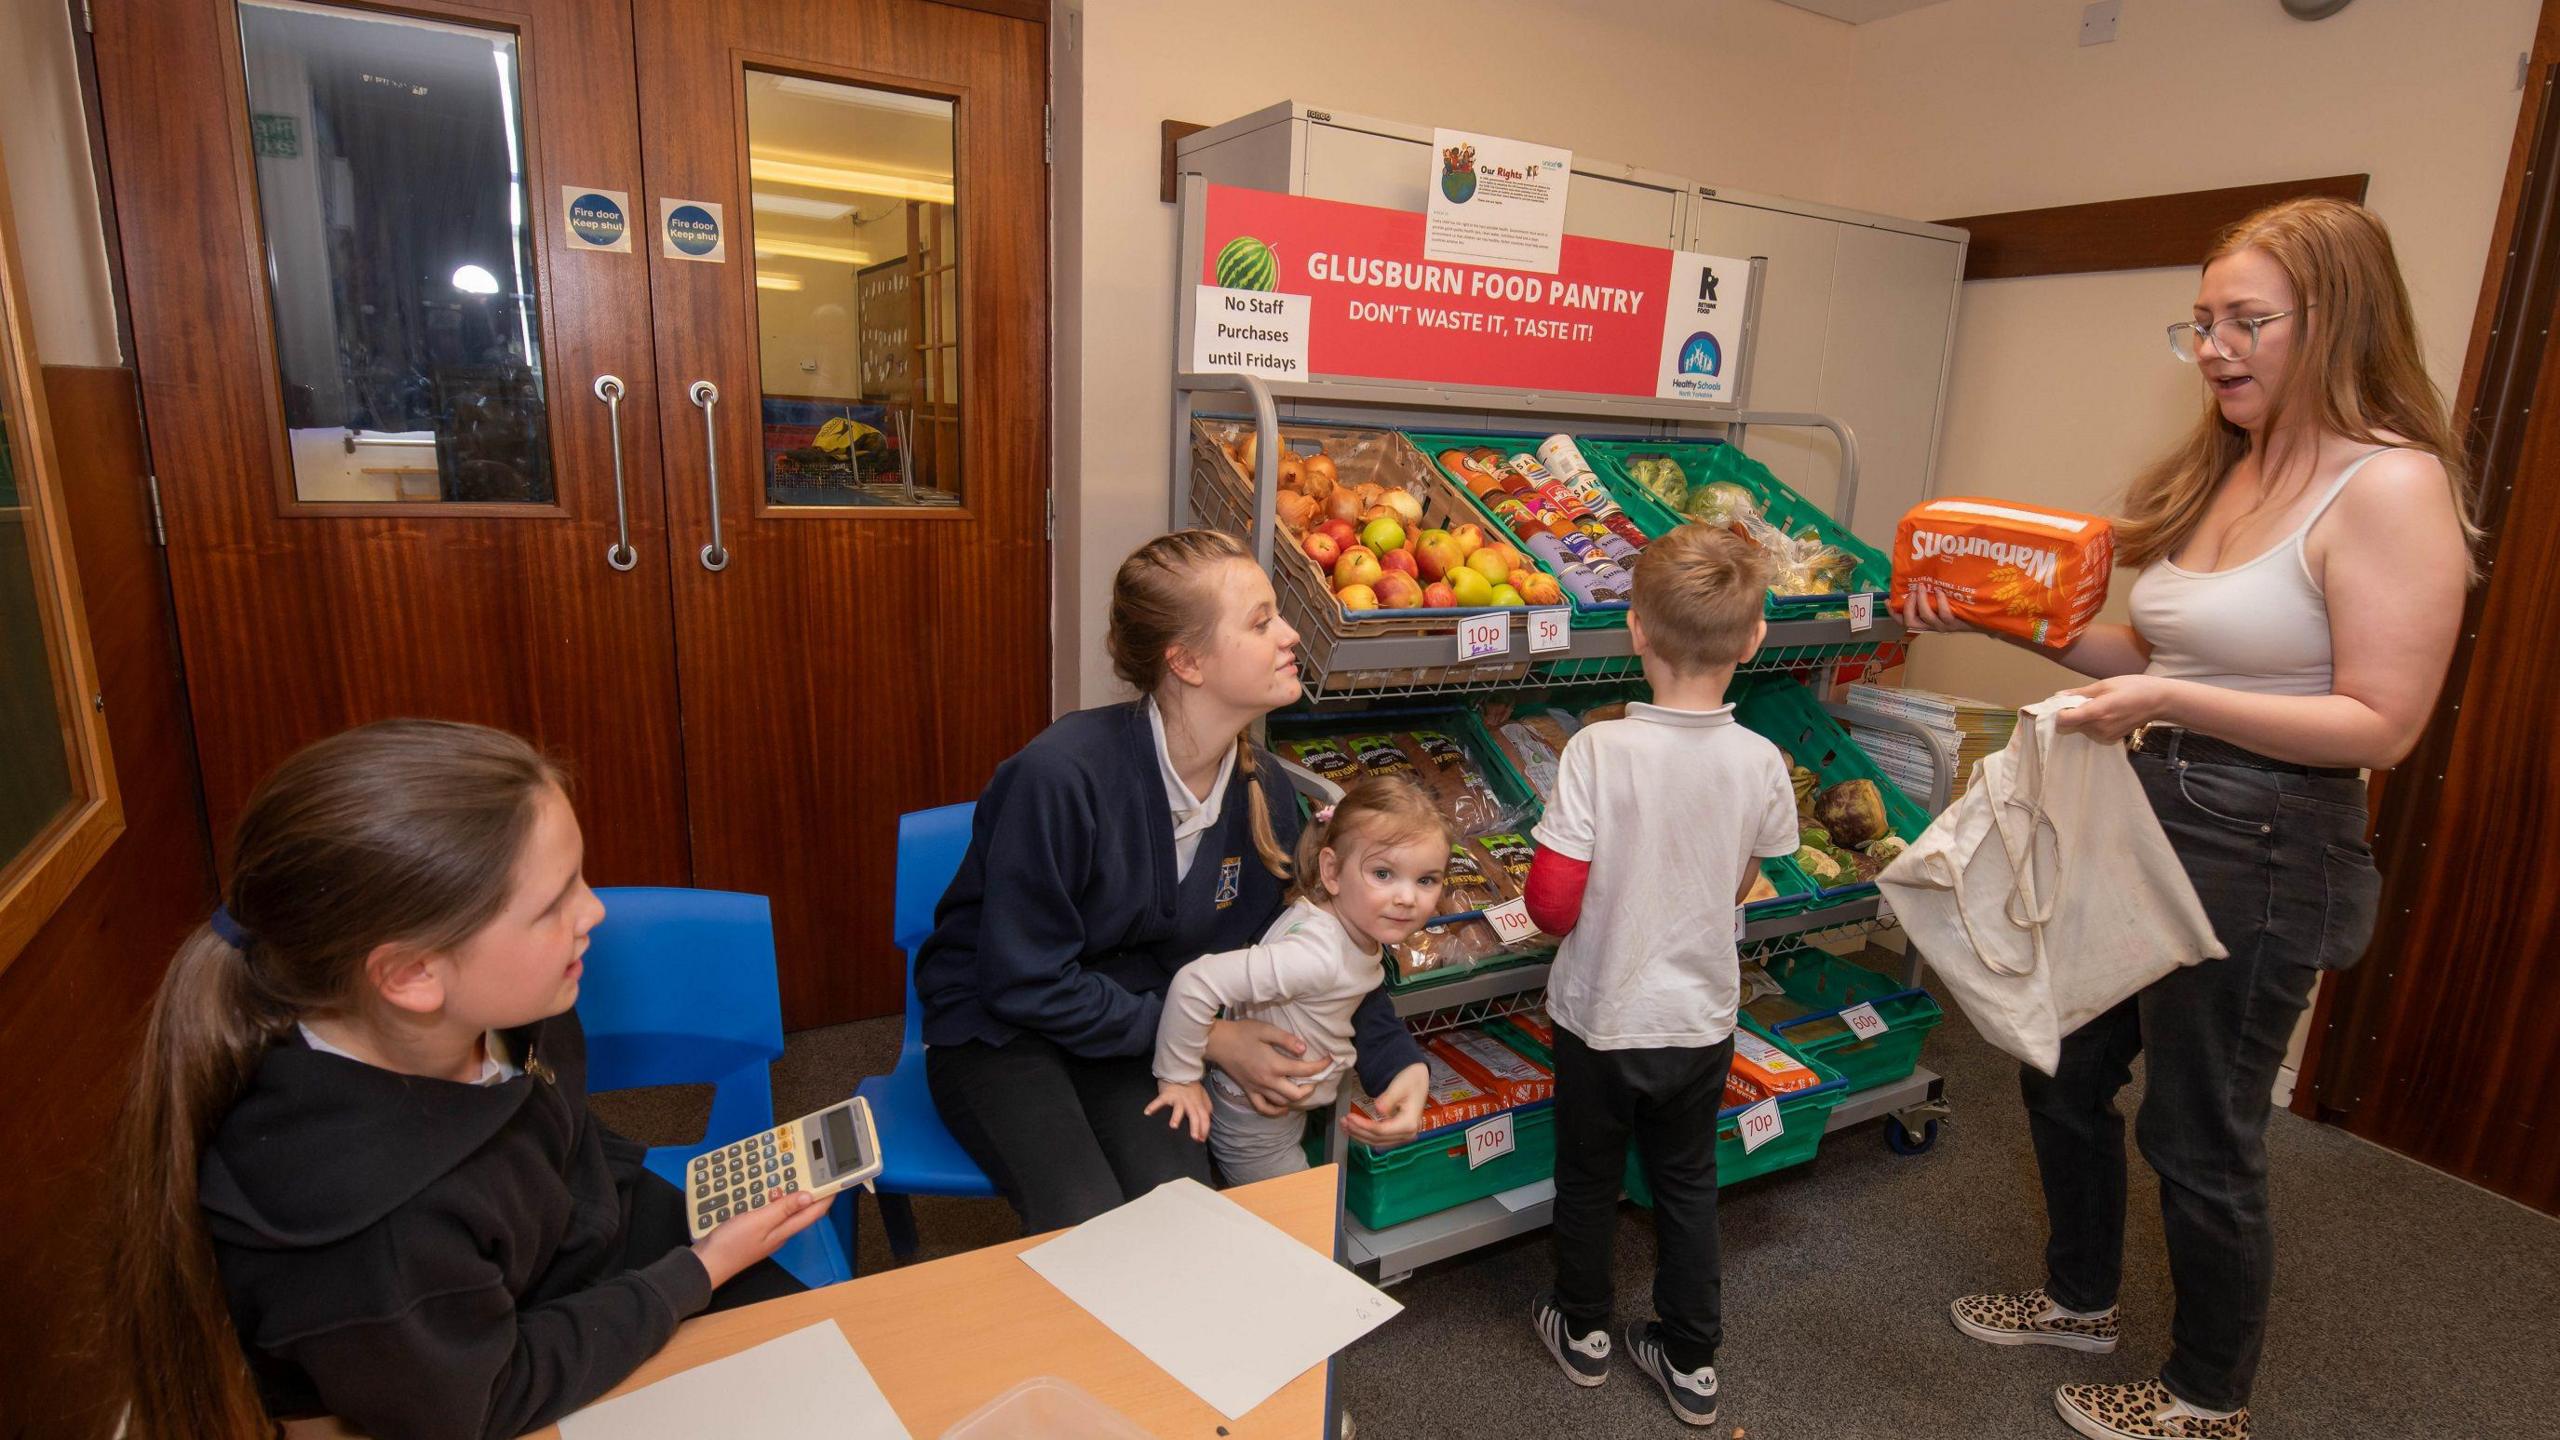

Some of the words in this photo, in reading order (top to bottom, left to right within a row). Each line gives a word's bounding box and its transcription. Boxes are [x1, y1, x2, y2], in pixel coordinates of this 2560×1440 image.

[1481, 165, 1496, 176] Our
[1497, 167, 1523, 180] Rights
[574, 207, 595, 218] Fire
[596, 209, 620, 221] door
[572, 218, 599, 231] Keep
[601, 220, 623, 232] shut
[671, 218, 691, 229] Fire
[692, 220, 714, 231] door
[670, 228, 695, 241] Keep
[697, 231, 718, 242] shut
[1307, 252, 1464, 295] GLUSBURN
[1471, 272, 1541, 304] FOOD
[1549, 280, 1644, 315] PANTRY
[1224, 295, 1247, 312] No
[1250, 297, 1285, 317] Staff
[1348, 300, 1412, 327] DON'T
[1416, 308, 1484, 332] WASTE
[1486, 315, 1509, 338] IT,
[1514, 316, 1570, 341] TASTE
[1572, 321, 1594, 343] IT!
[1217, 322, 1290, 345] Purchases
[1208, 348, 1243, 370] until
[1246, 351, 1297, 375] Fridays
[1672, 377, 1698, 391] Healthy
[1697, 380, 1721, 392] Schools
[1911, 529, 2057, 589] Warburtons
[1467, 625, 1500, 645] 10p
[1540, 620, 1558, 640] 5p
[1494, 911, 1528, 932] 70p
[1852, 1015, 1878, 1031] 60p
[1746, 1112, 1773, 1137] 70p
[1475, 1129, 1505, 1152] 70p
